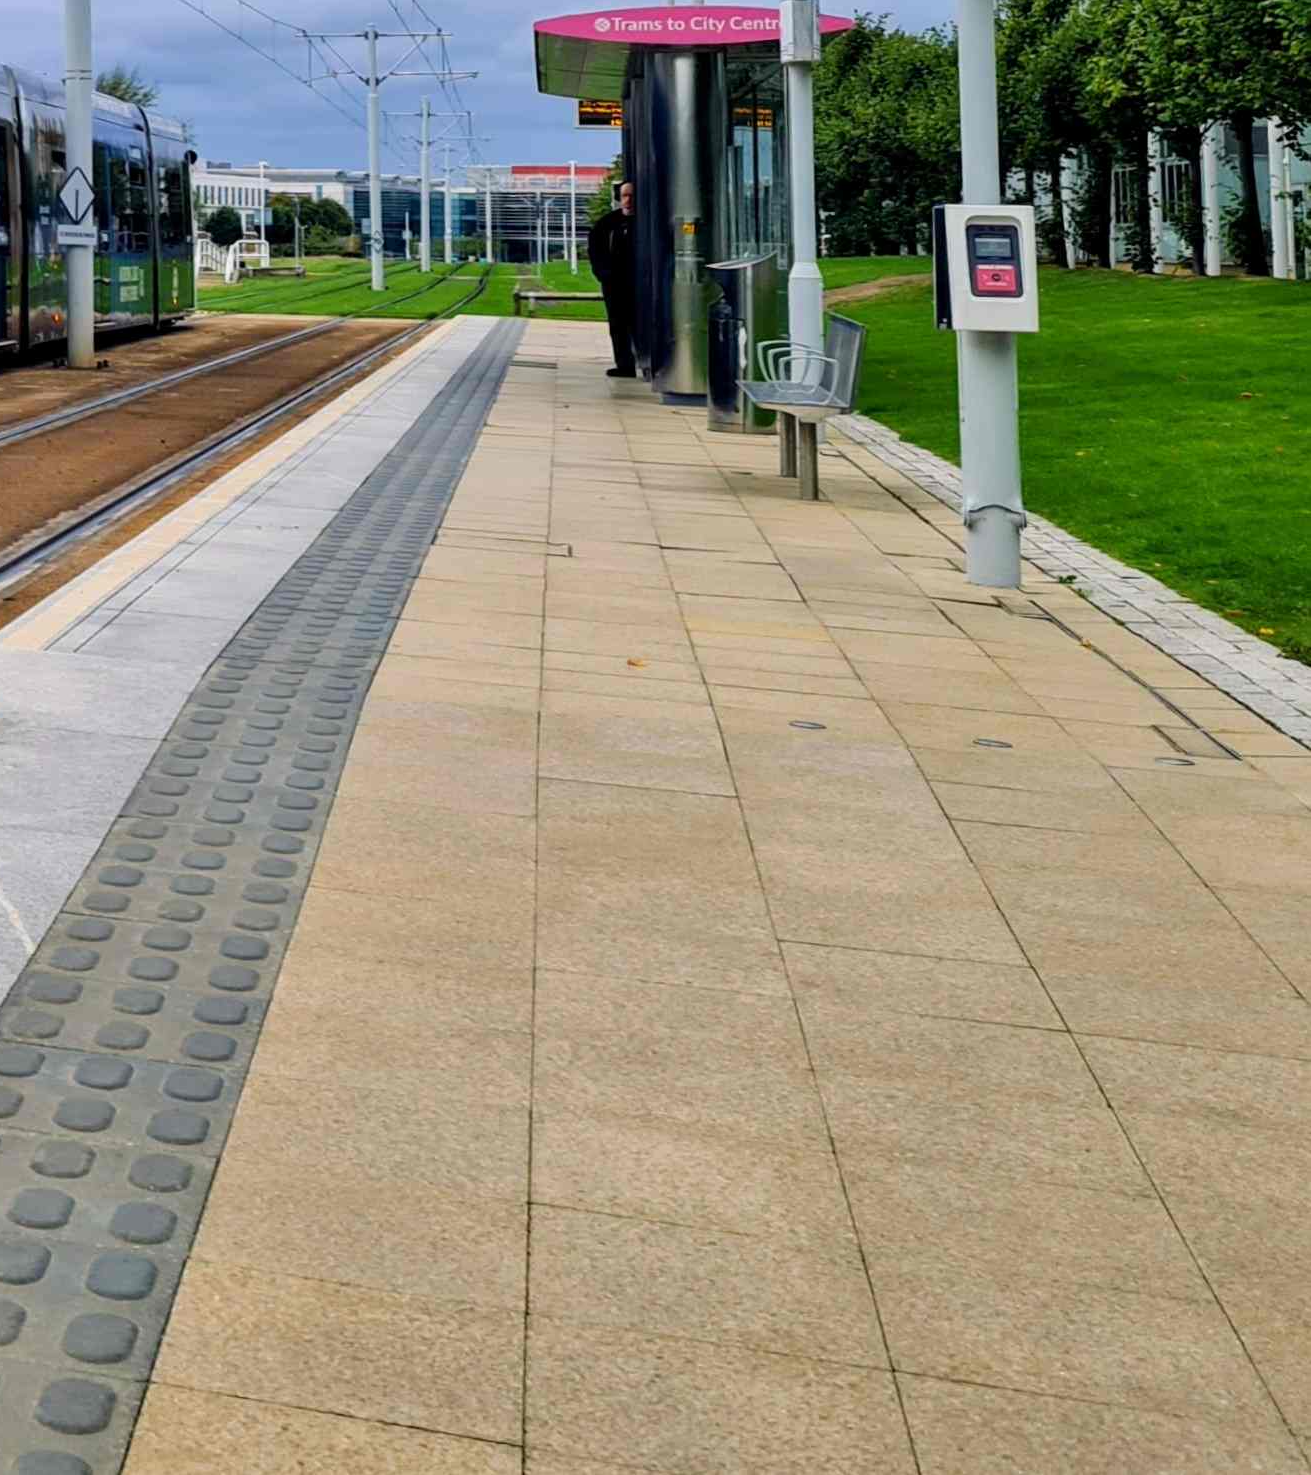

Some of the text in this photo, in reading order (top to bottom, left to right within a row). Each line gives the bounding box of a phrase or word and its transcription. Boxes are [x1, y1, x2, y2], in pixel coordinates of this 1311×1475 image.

[612, 16, 780, 34] Trams to City Centr
